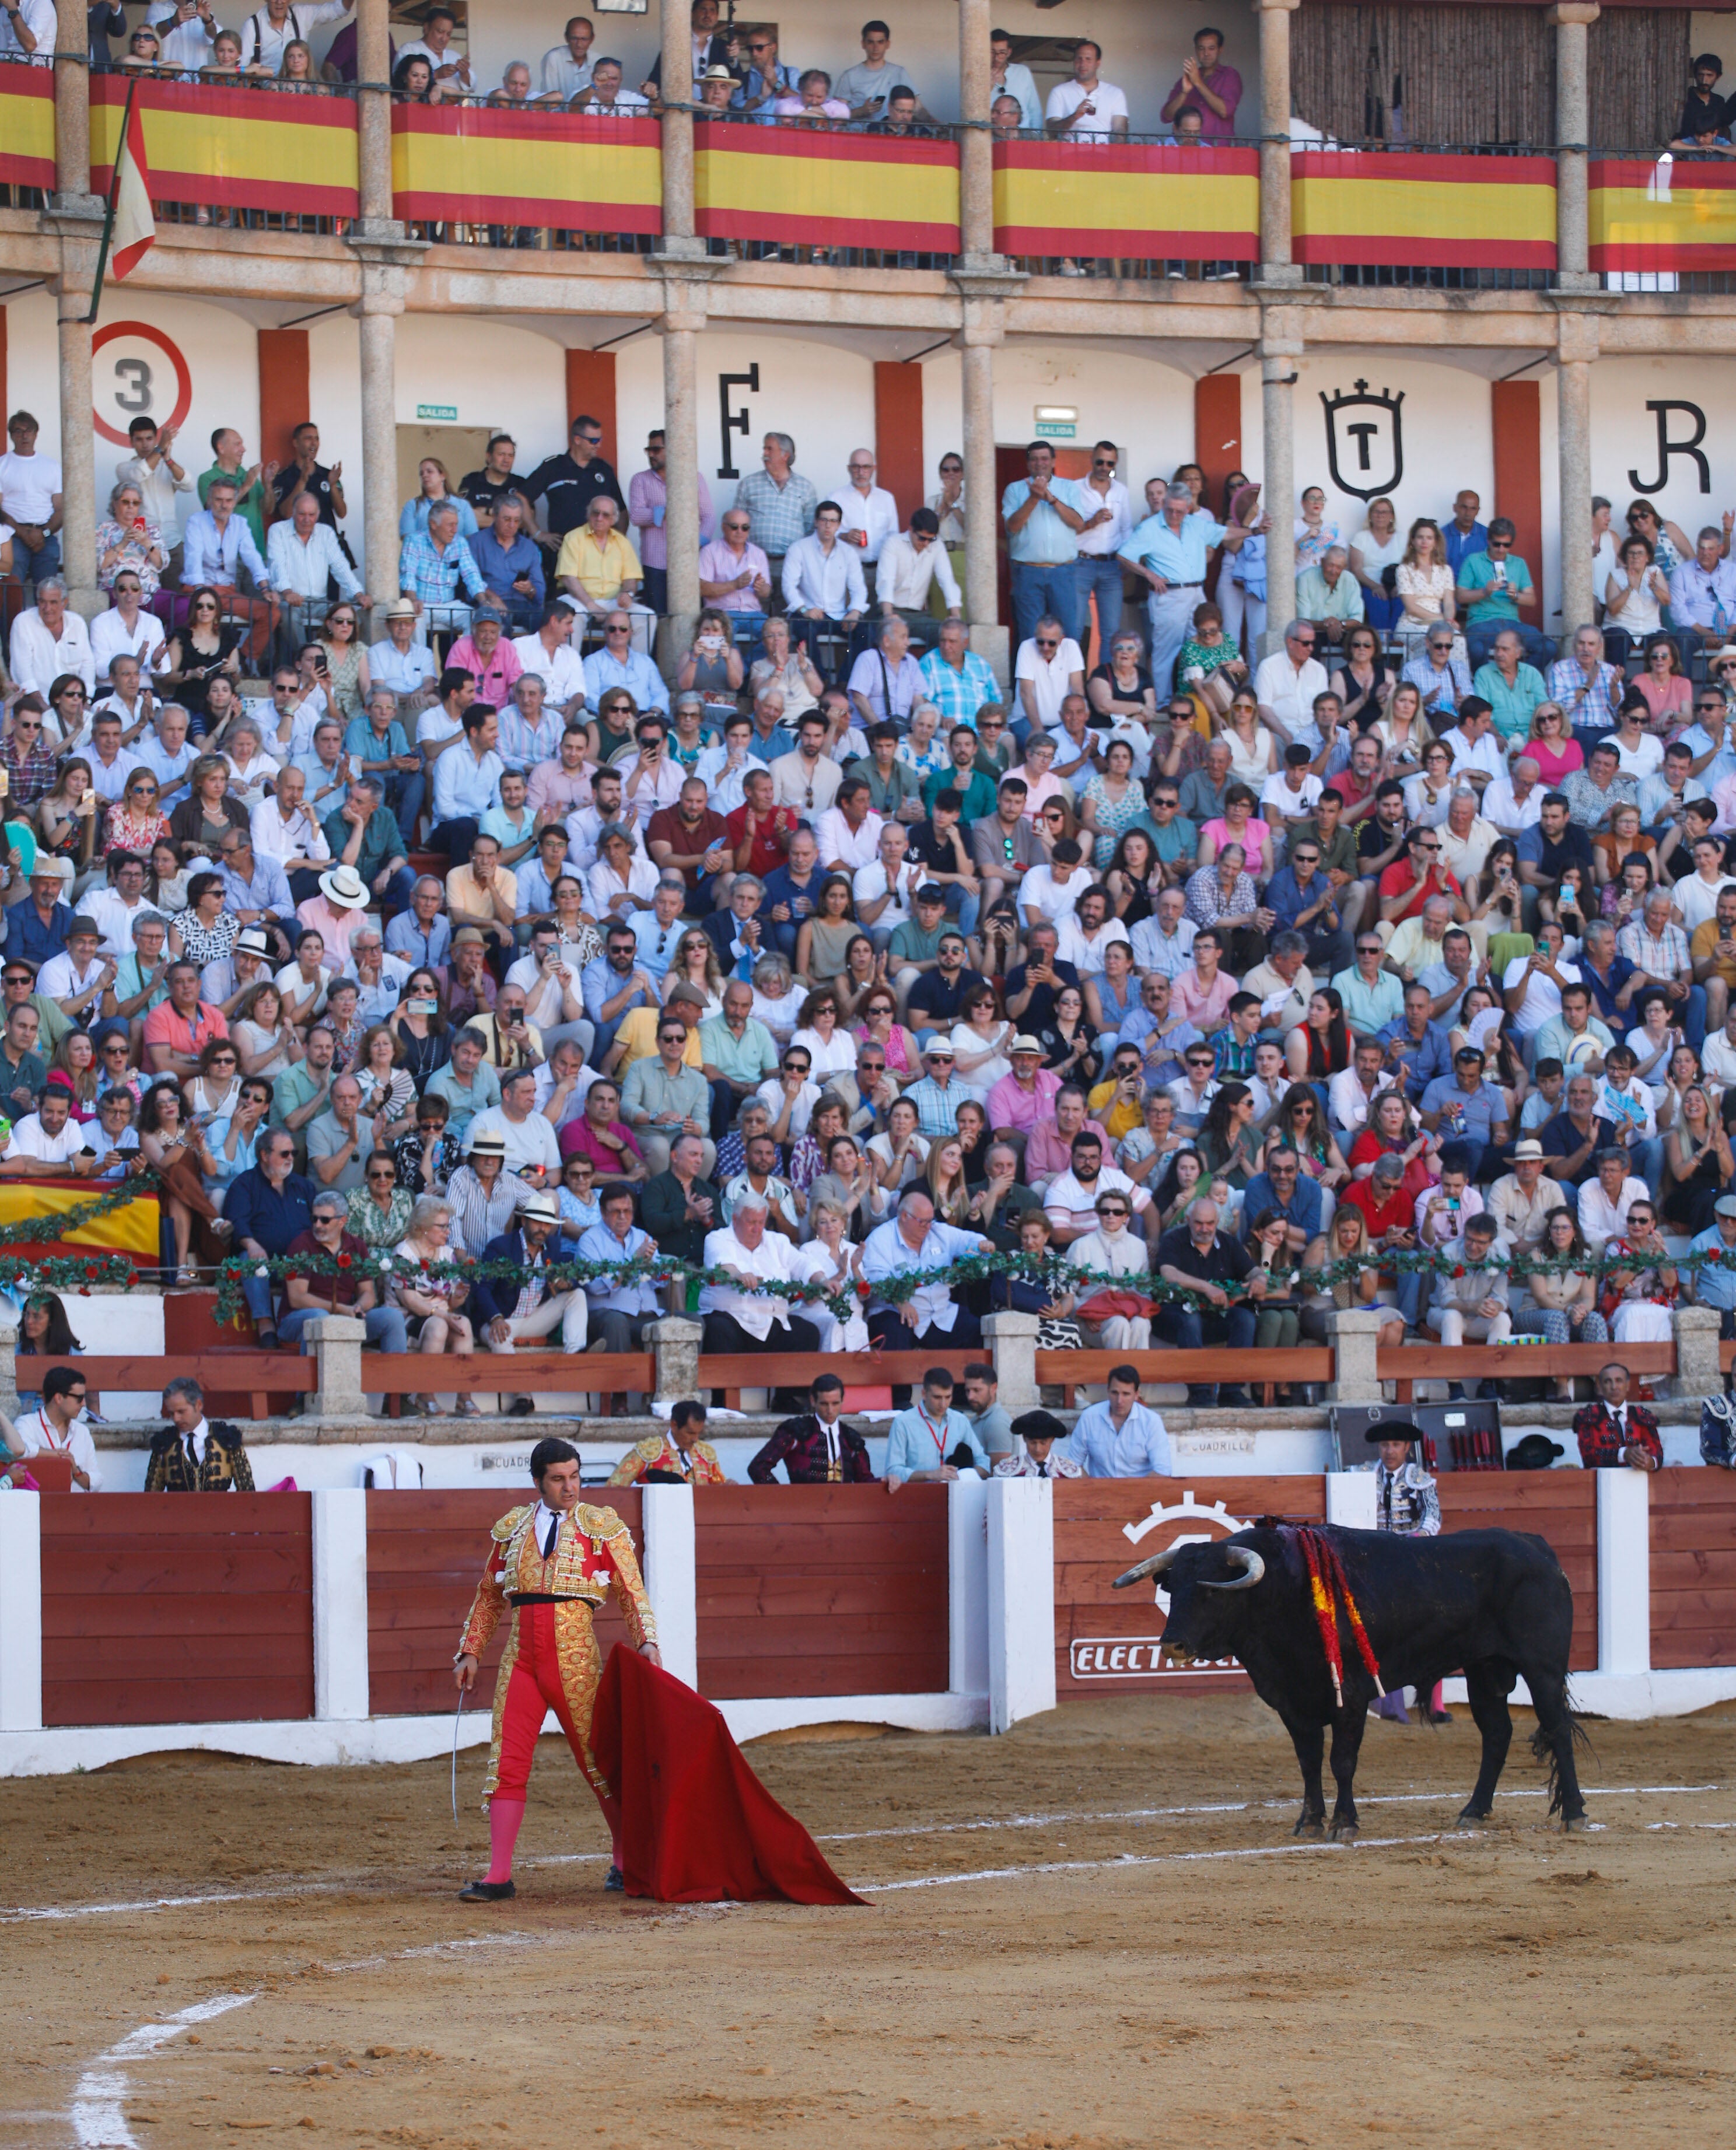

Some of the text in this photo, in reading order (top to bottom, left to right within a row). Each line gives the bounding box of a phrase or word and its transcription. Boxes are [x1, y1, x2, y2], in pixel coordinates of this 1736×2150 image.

[114, 359, 152, 412] 3
[418, 408, 456, 419] SALIDA
[717, 363, 760, 479] F
[1036, 425, 1074, 436] SALIDA
[1347, 423, 1378, 470] T
[495, 1456, 531, 1468] CUADR
[1077, 1645, 1240, 1671] ELECT
